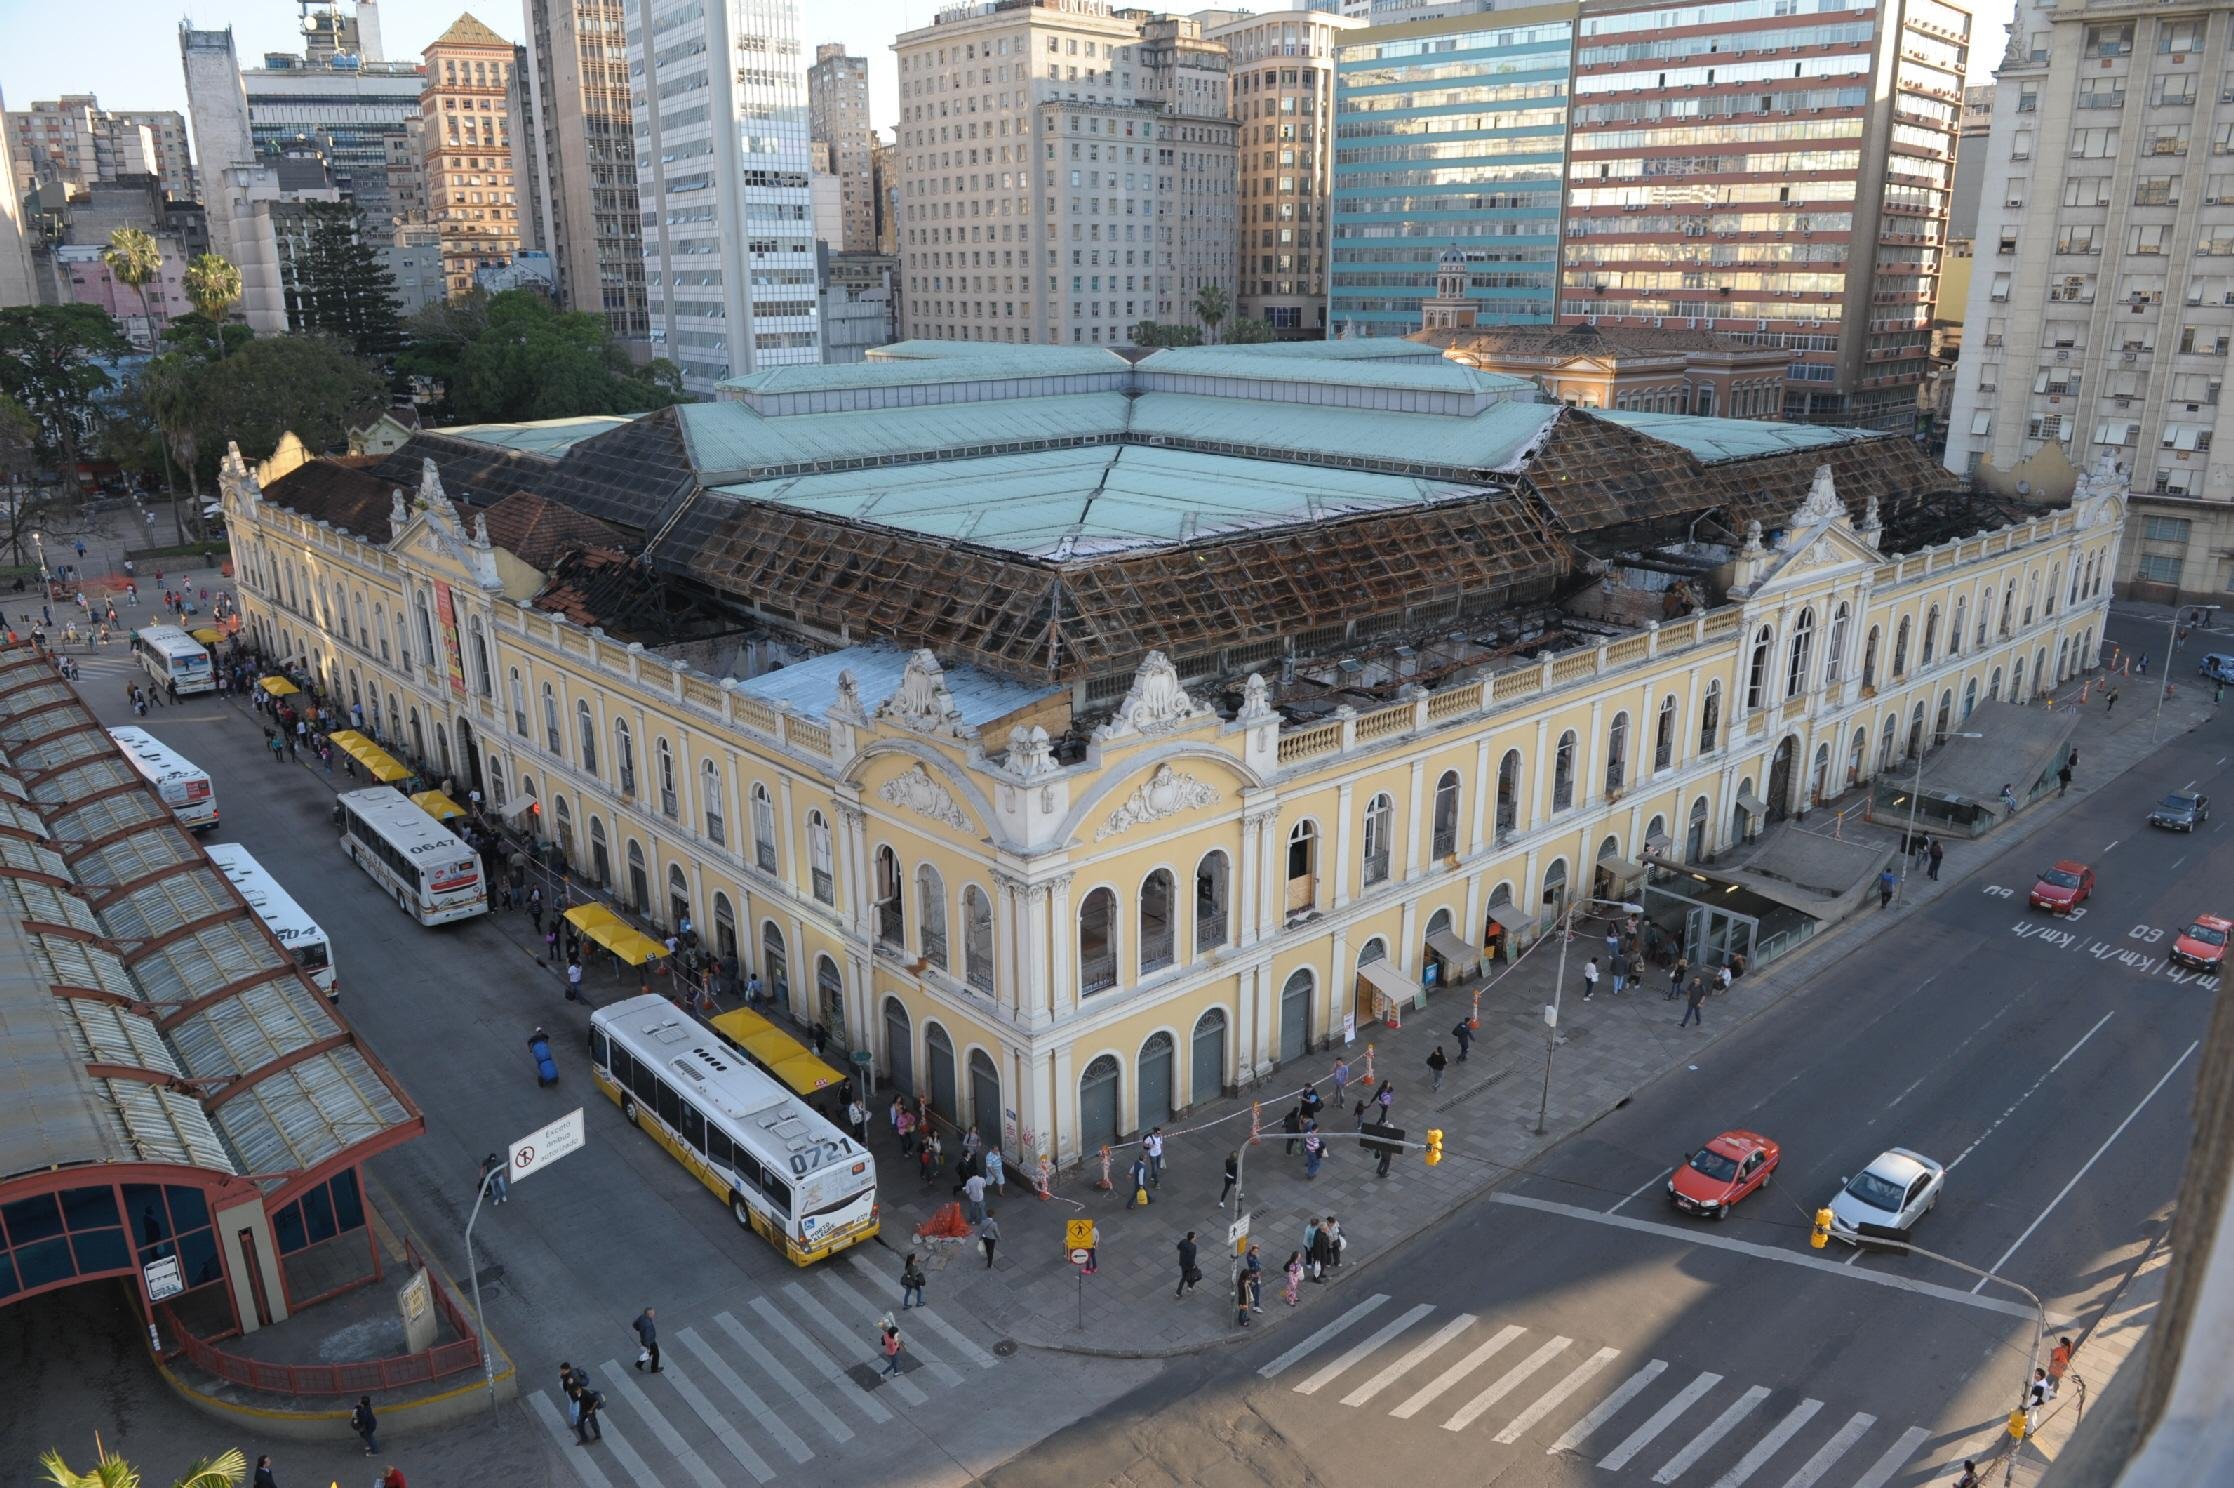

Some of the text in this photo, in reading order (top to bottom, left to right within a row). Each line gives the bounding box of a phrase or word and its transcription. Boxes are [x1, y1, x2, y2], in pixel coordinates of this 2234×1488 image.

[410, 839, 454, 853] 0647
[2128, 924, 2165, 942] 60
[789, 1138, 852, 1174] 0721
